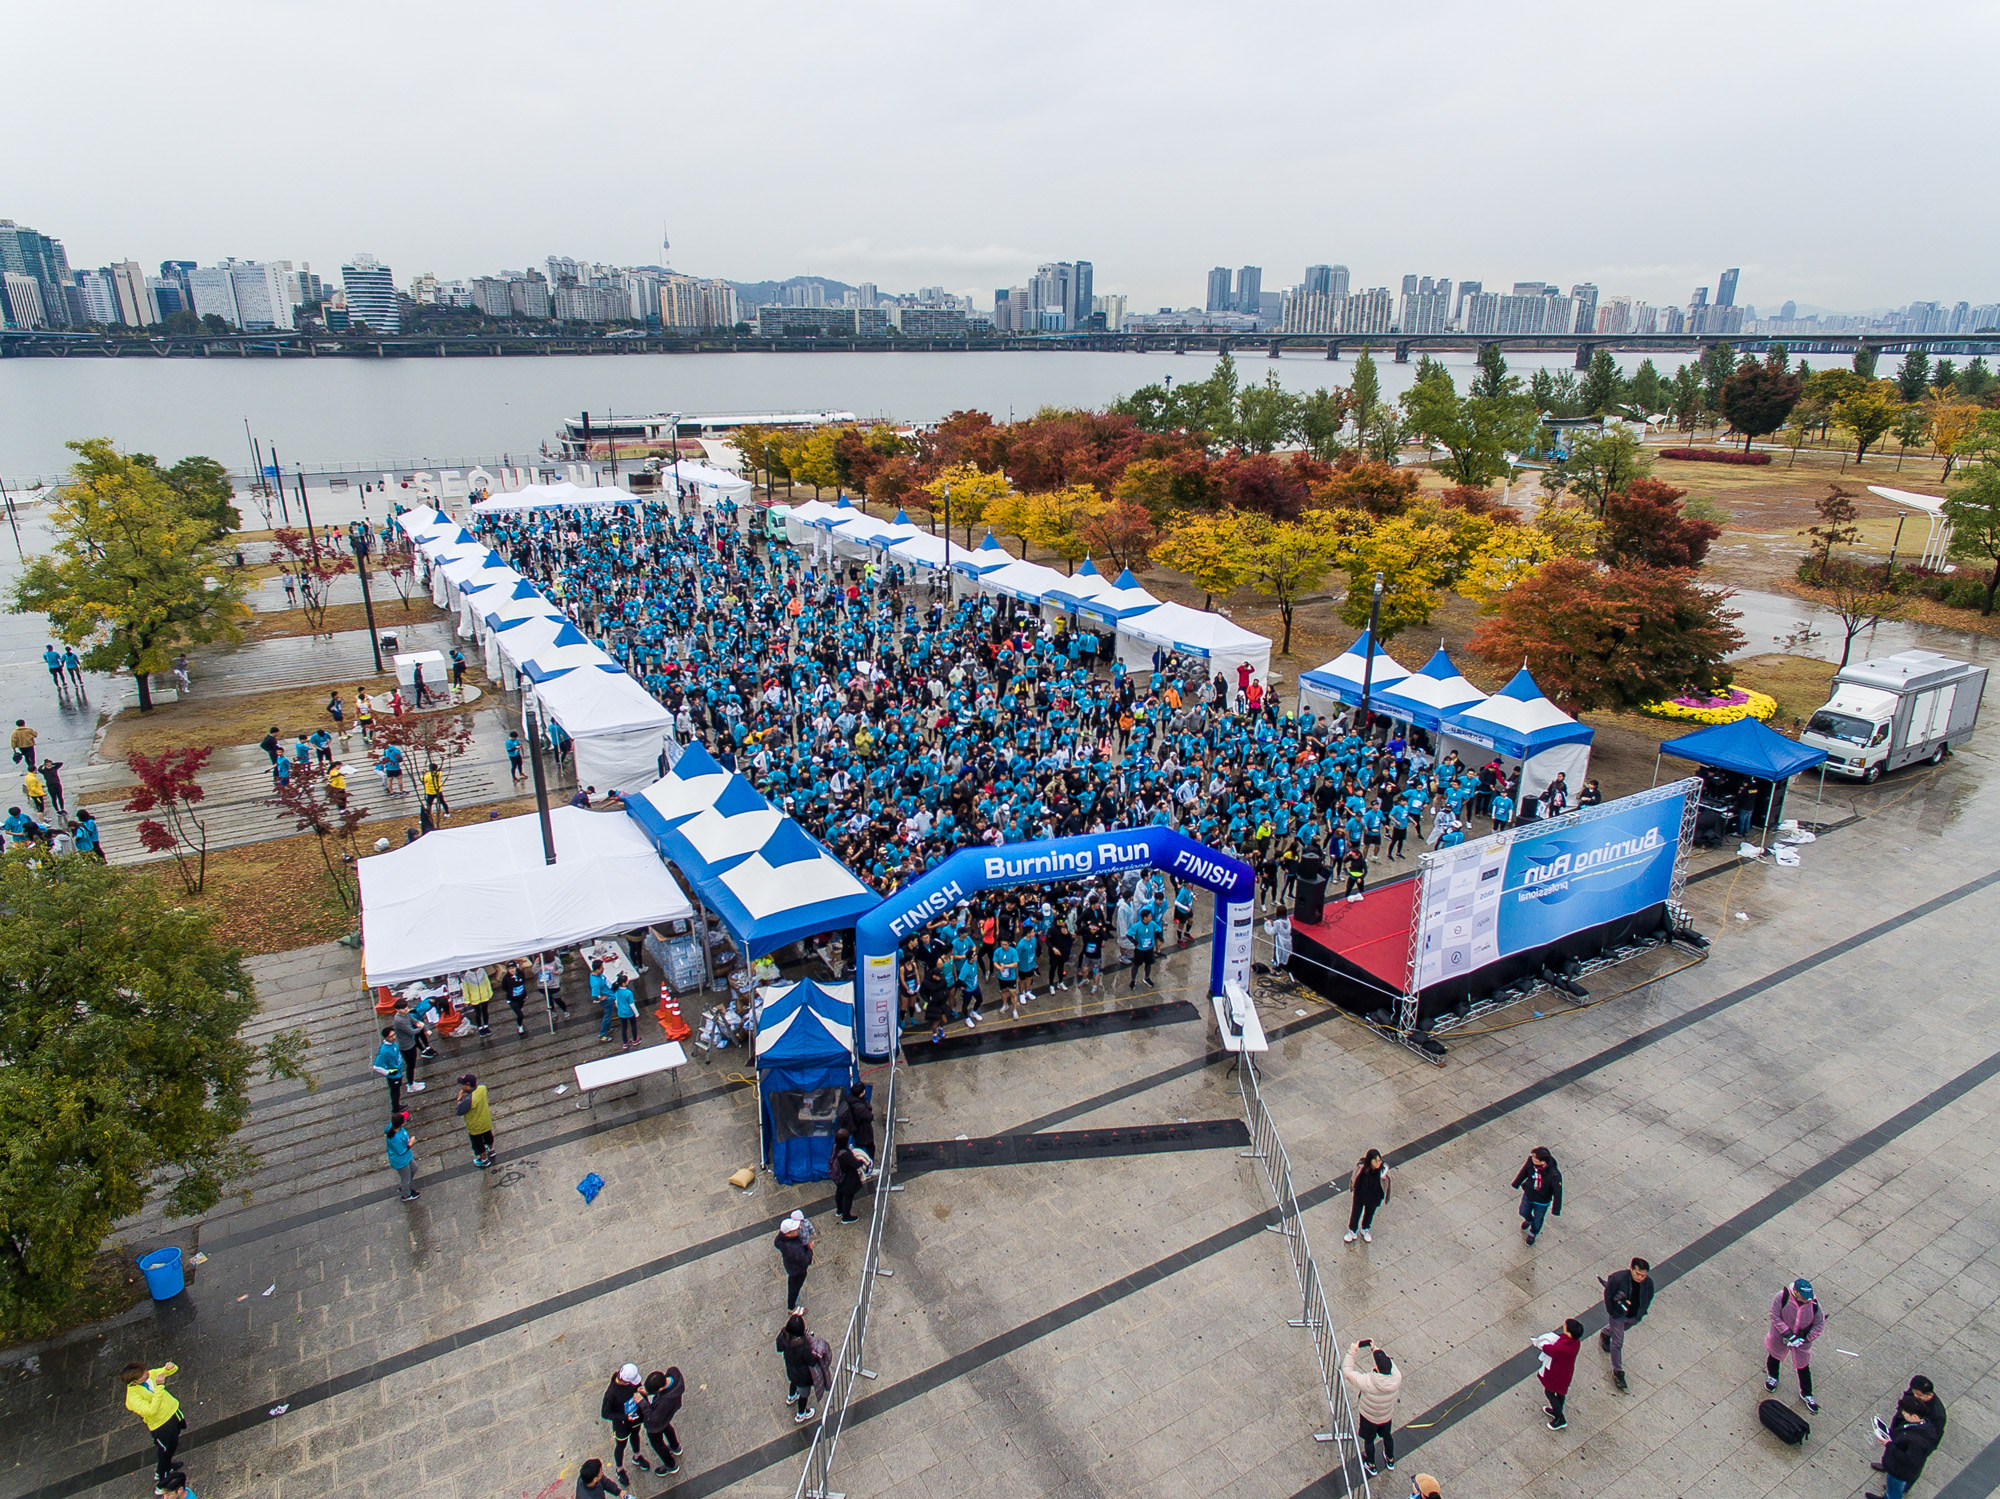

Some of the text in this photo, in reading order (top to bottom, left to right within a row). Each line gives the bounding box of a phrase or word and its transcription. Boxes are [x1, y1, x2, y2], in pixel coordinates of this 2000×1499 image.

[984, 842, 1150, 880] Burning Run
[1094, 861, 1153, 876] professional
[1173, 850, 1239, 890] FINISH
[888, 880, 963, 937] FINISH
